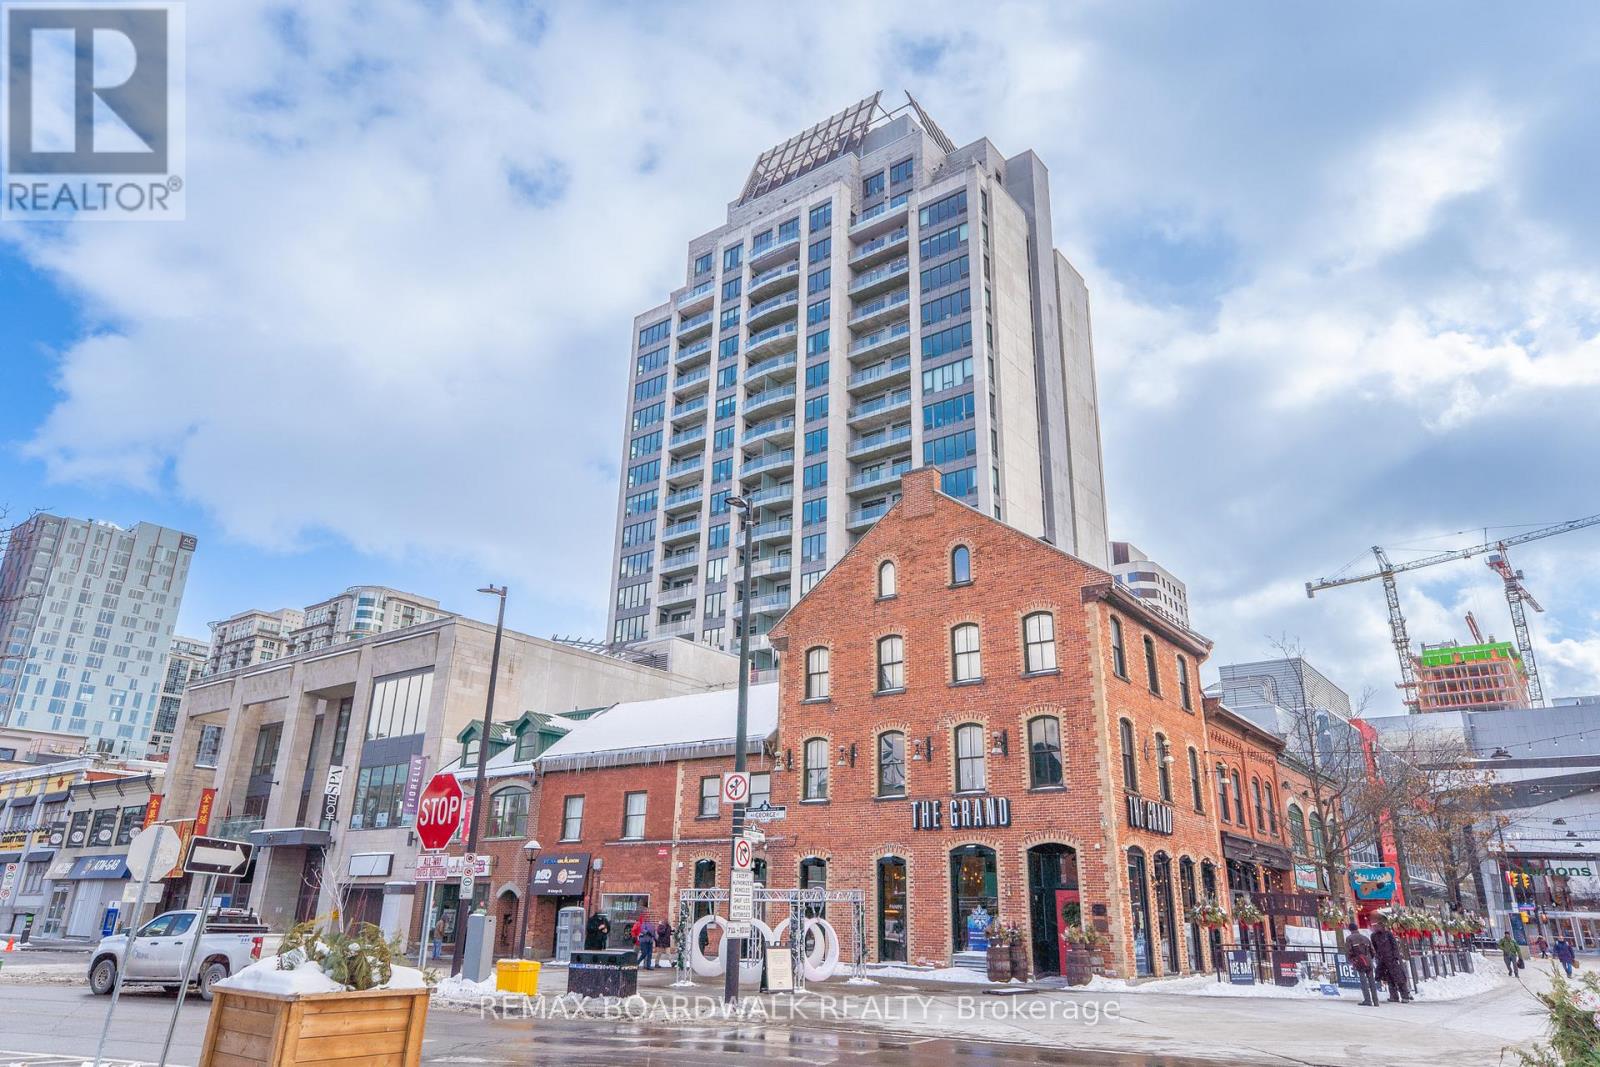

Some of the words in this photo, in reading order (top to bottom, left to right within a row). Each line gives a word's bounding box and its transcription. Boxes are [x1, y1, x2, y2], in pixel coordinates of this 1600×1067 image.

[406, 758, 423, 809] FIORELLA
[419, 795, 460, 826] STOP
[911, 800, 941, 829] THE
[949, 797, 1010, 827] GRAND
[1128, 795, 1145, 829] THE
[1147, 801, 1172, 834] GRAND
[1230, 962, 1240, 975] ICE
[1339, 964, 1355, 978] ICE
